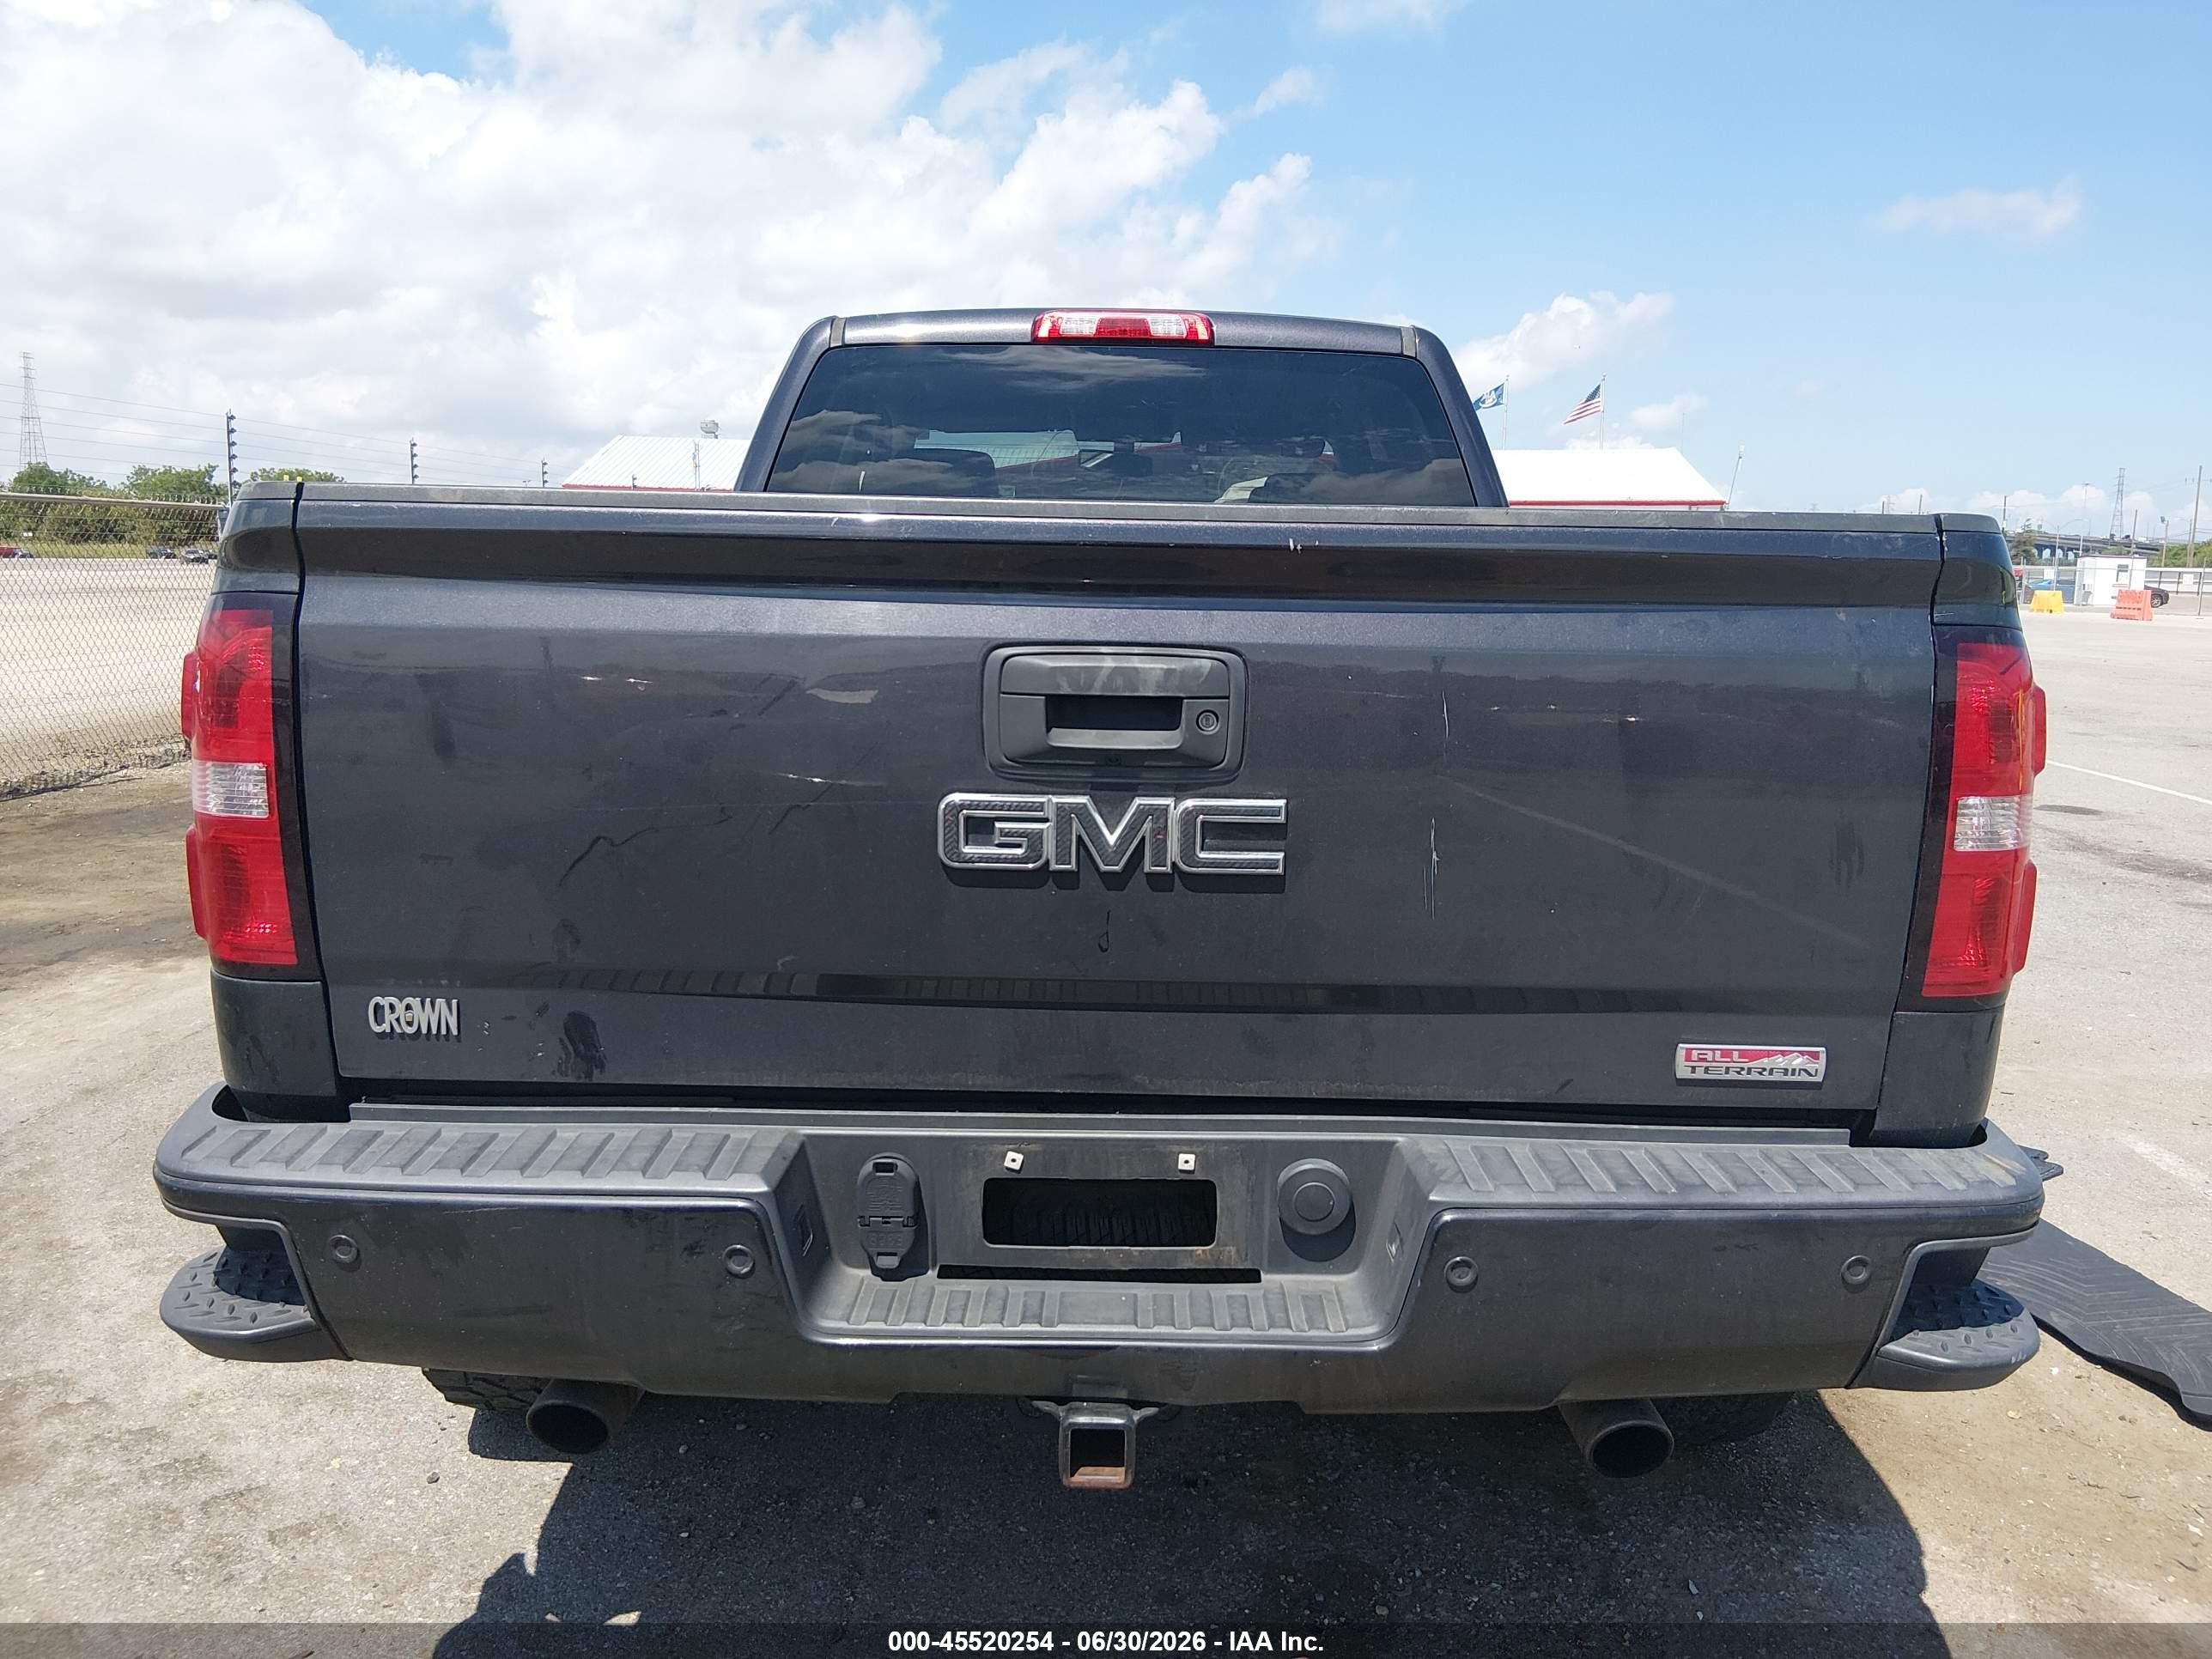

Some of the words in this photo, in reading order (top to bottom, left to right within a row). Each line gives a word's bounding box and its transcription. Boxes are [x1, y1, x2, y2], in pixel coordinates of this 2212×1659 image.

[938, 793, 1287, 875] GMC
[368, 996, 459, 1036] CROWN
[1691, 1049, 1750, 1062] ALL
[1684, 1065, 1819, 1078] TERRAIN
